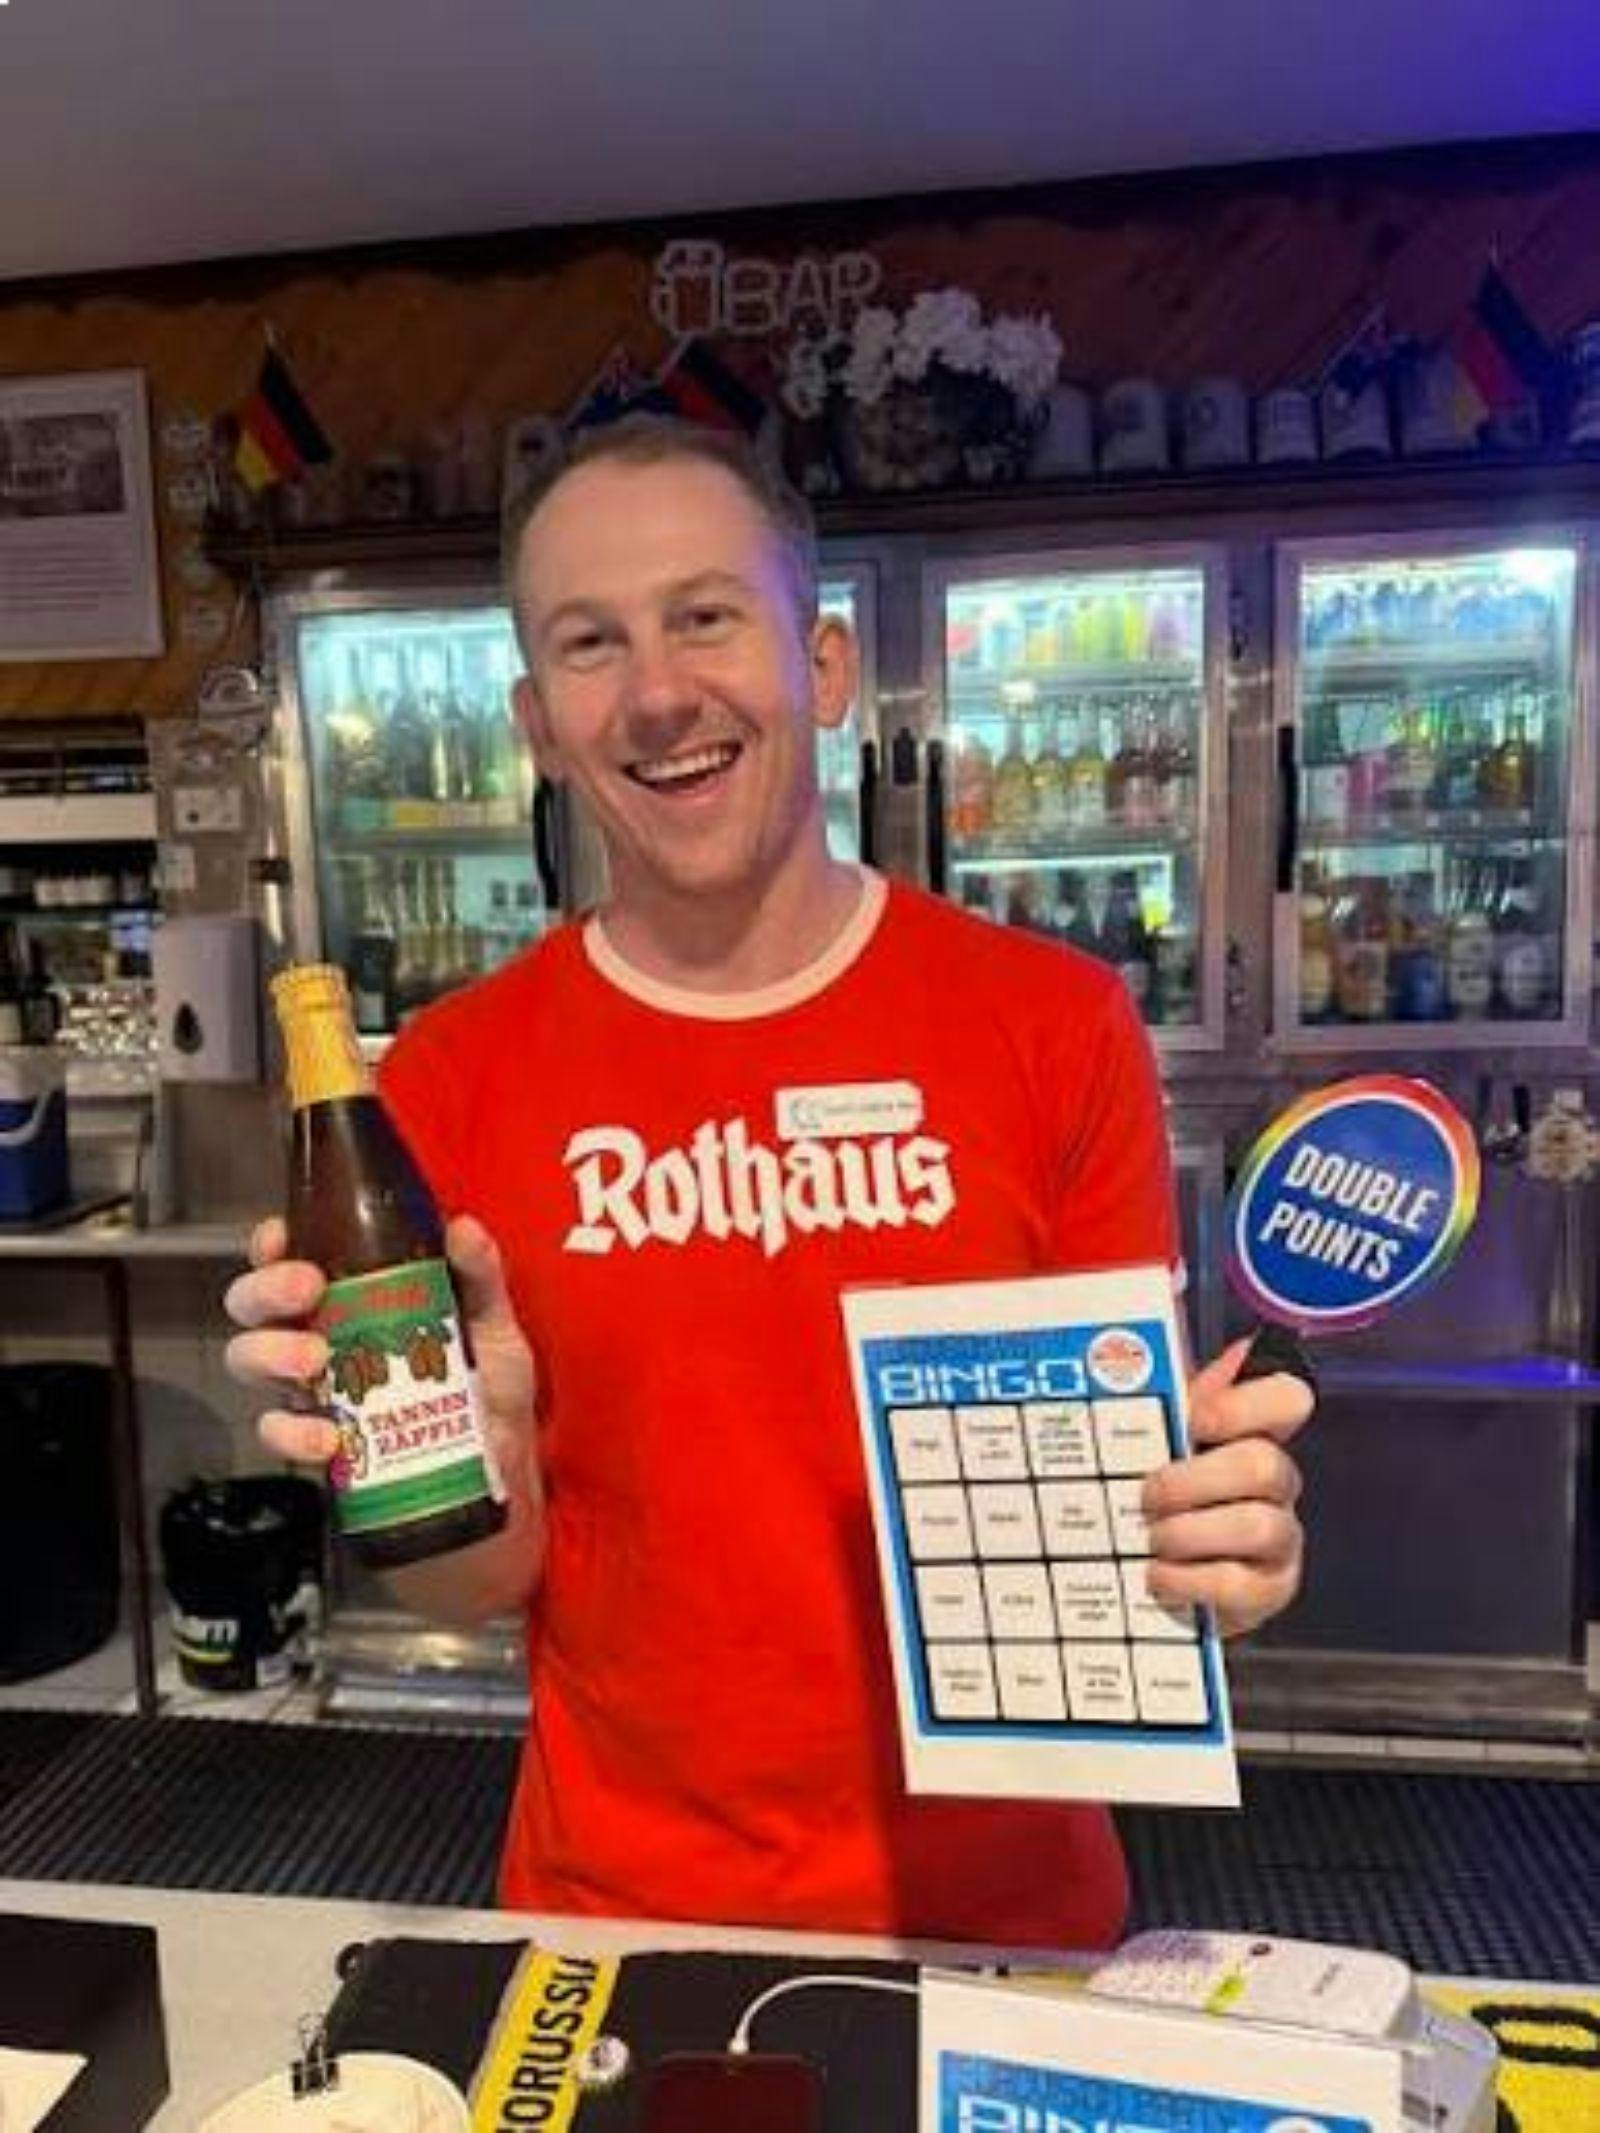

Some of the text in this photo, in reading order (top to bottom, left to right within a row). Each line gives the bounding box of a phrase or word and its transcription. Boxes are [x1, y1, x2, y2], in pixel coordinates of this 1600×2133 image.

[562, 1115, 956, 1260] Rothaus
[1283, 1143, 1440, 1233] DOUBLE
[1257, 1201, 1402, 1281] POINTS
[878, 1357, 1088, 1403] BINGO
